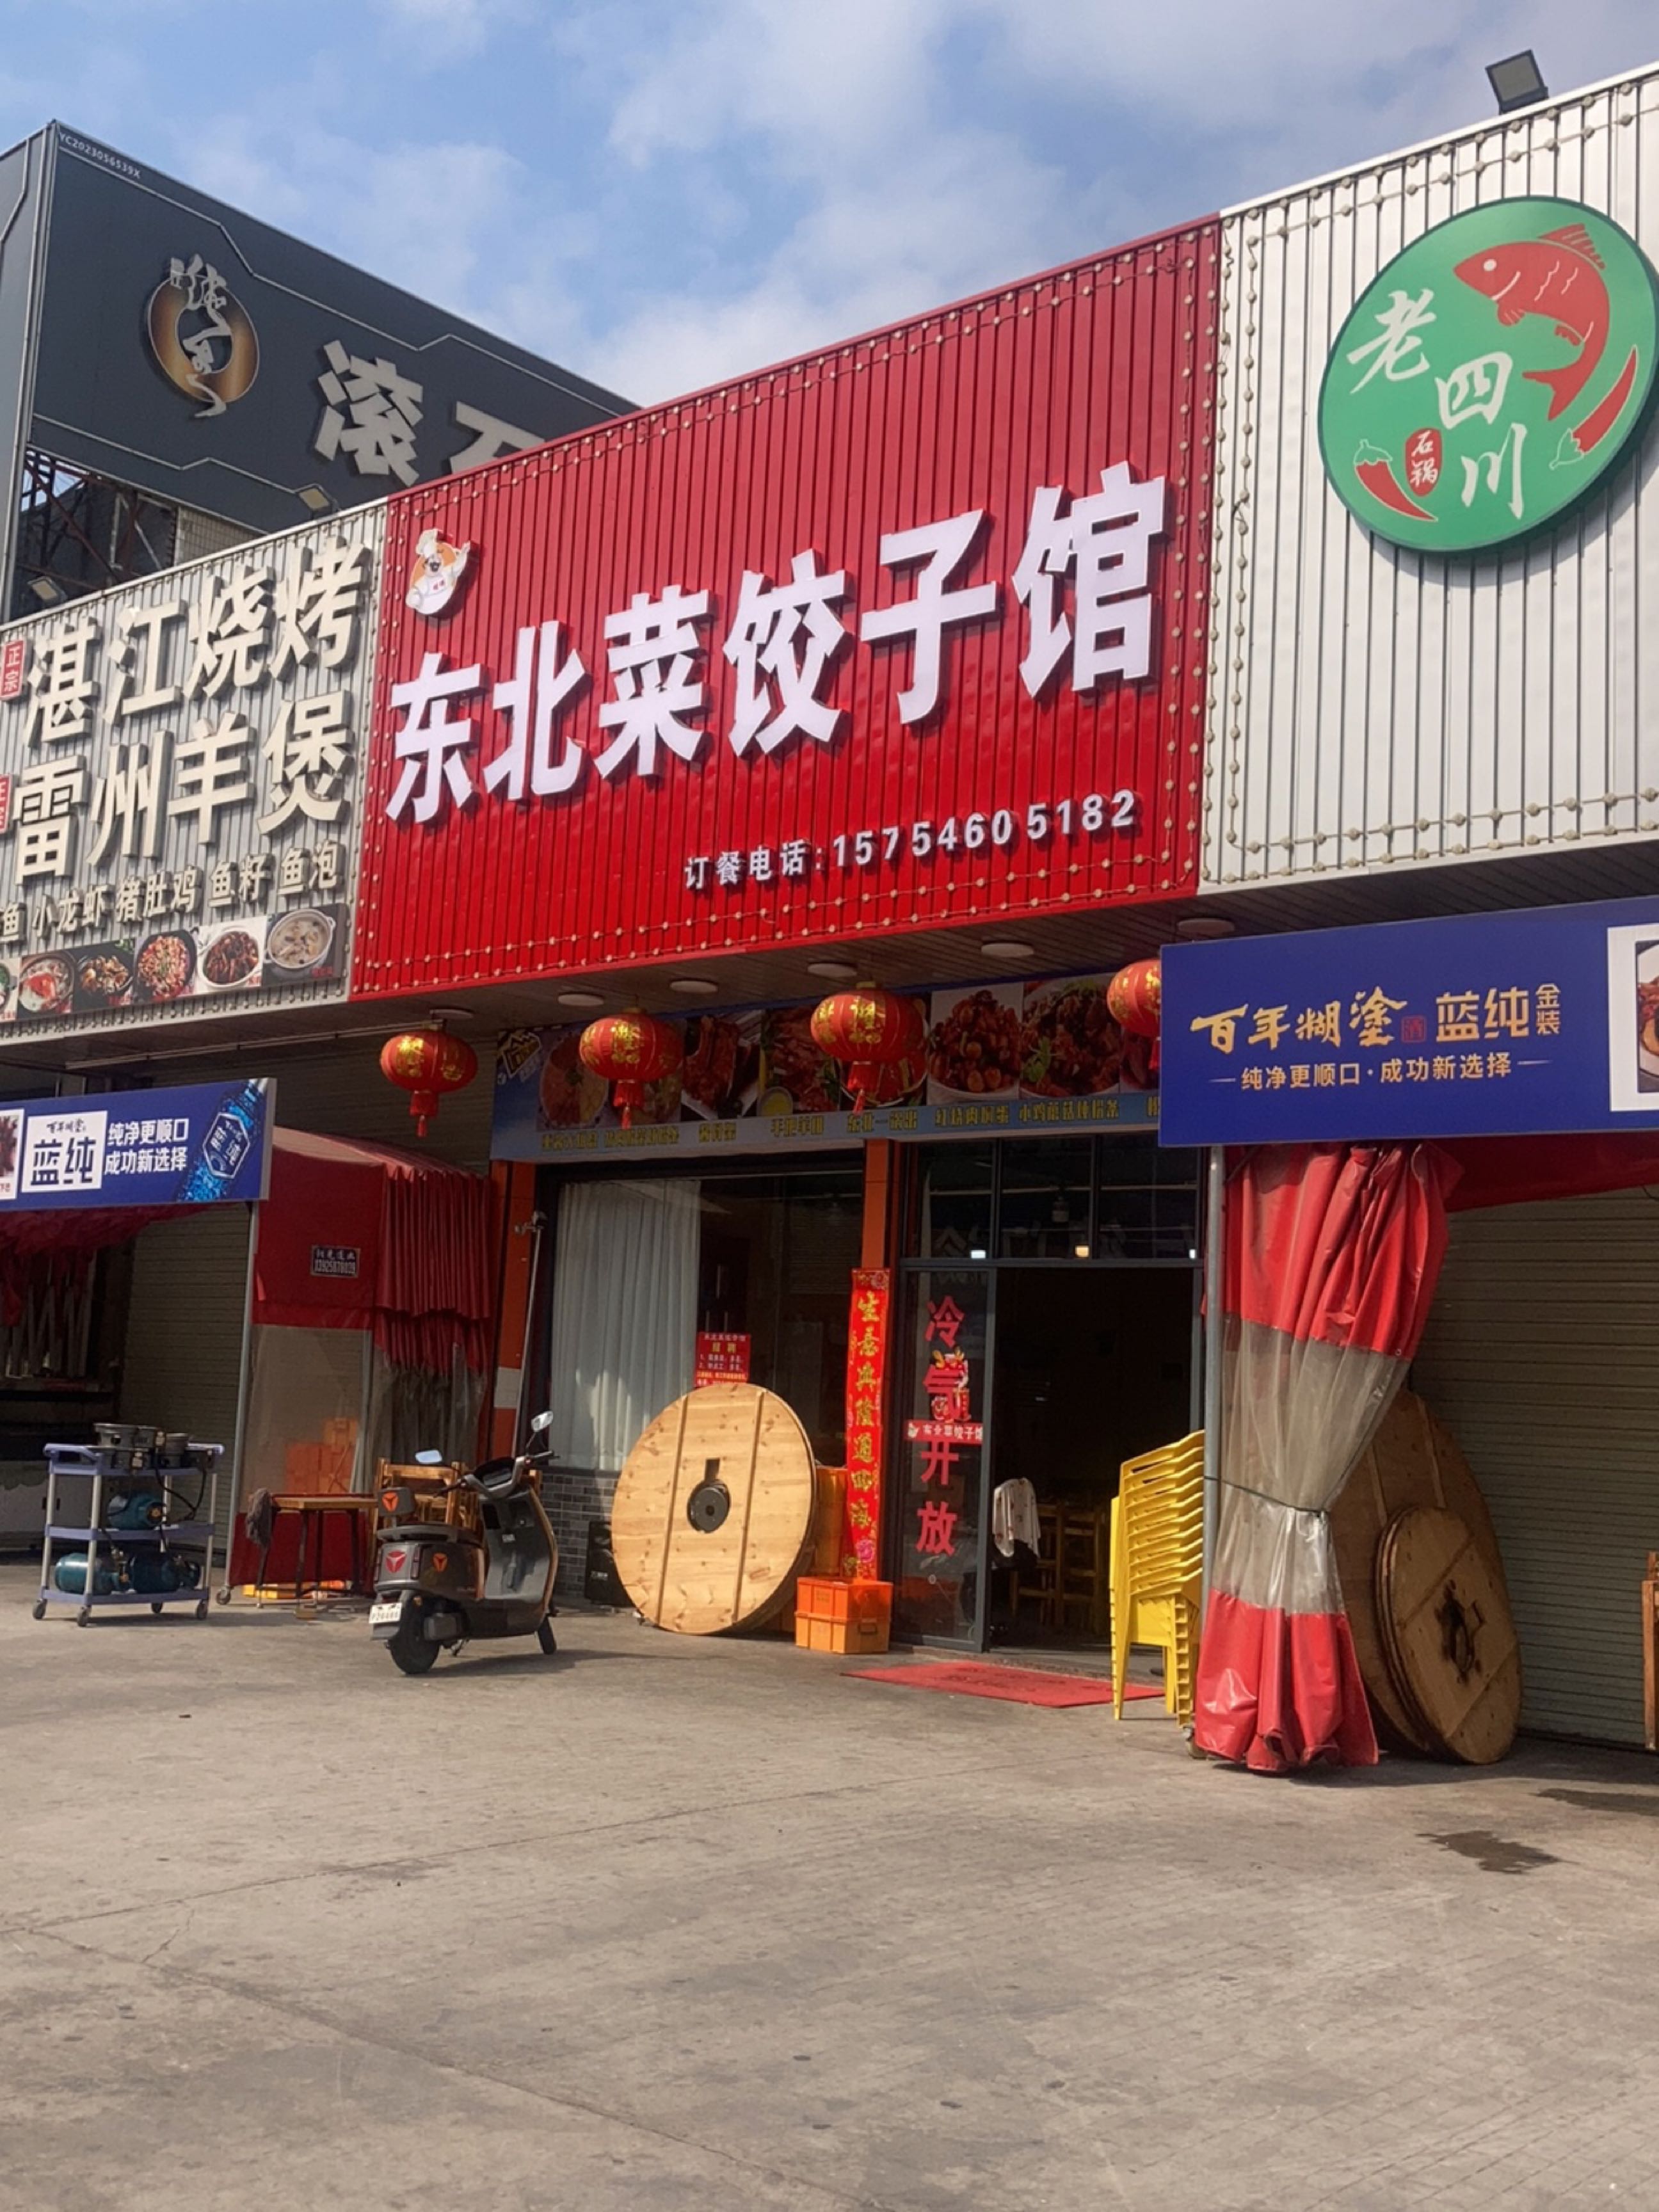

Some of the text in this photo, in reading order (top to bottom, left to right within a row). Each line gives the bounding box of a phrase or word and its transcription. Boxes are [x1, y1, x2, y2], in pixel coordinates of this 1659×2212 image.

[1347, 288, 1527, 520] 老四川
[4, 646, 21, 693] 正宗
[24, 536, 364, 748] 湛江烧烤
[385, 461, 1166, 824] 东北菜饺子馆
[13, 690, 353, 886] 雷州羊煲
[32, 885, 111, 937] 小龙虾
[117, 865, 200, 922] 猪肚鸡
[209, 853, 271, 907] 鱼籽
[277, 840, 341, 895] 鱼泡
[1436, 986, 1530, 1042] 蓝纯
[1535, 983, 1562, 1035] 金装
[30, 1136, 96, 1185] 蓝纯
[104, 1146, 188, 1175] 成功新选择
[107, 1118, 189, 1146] 纯净更顺口
